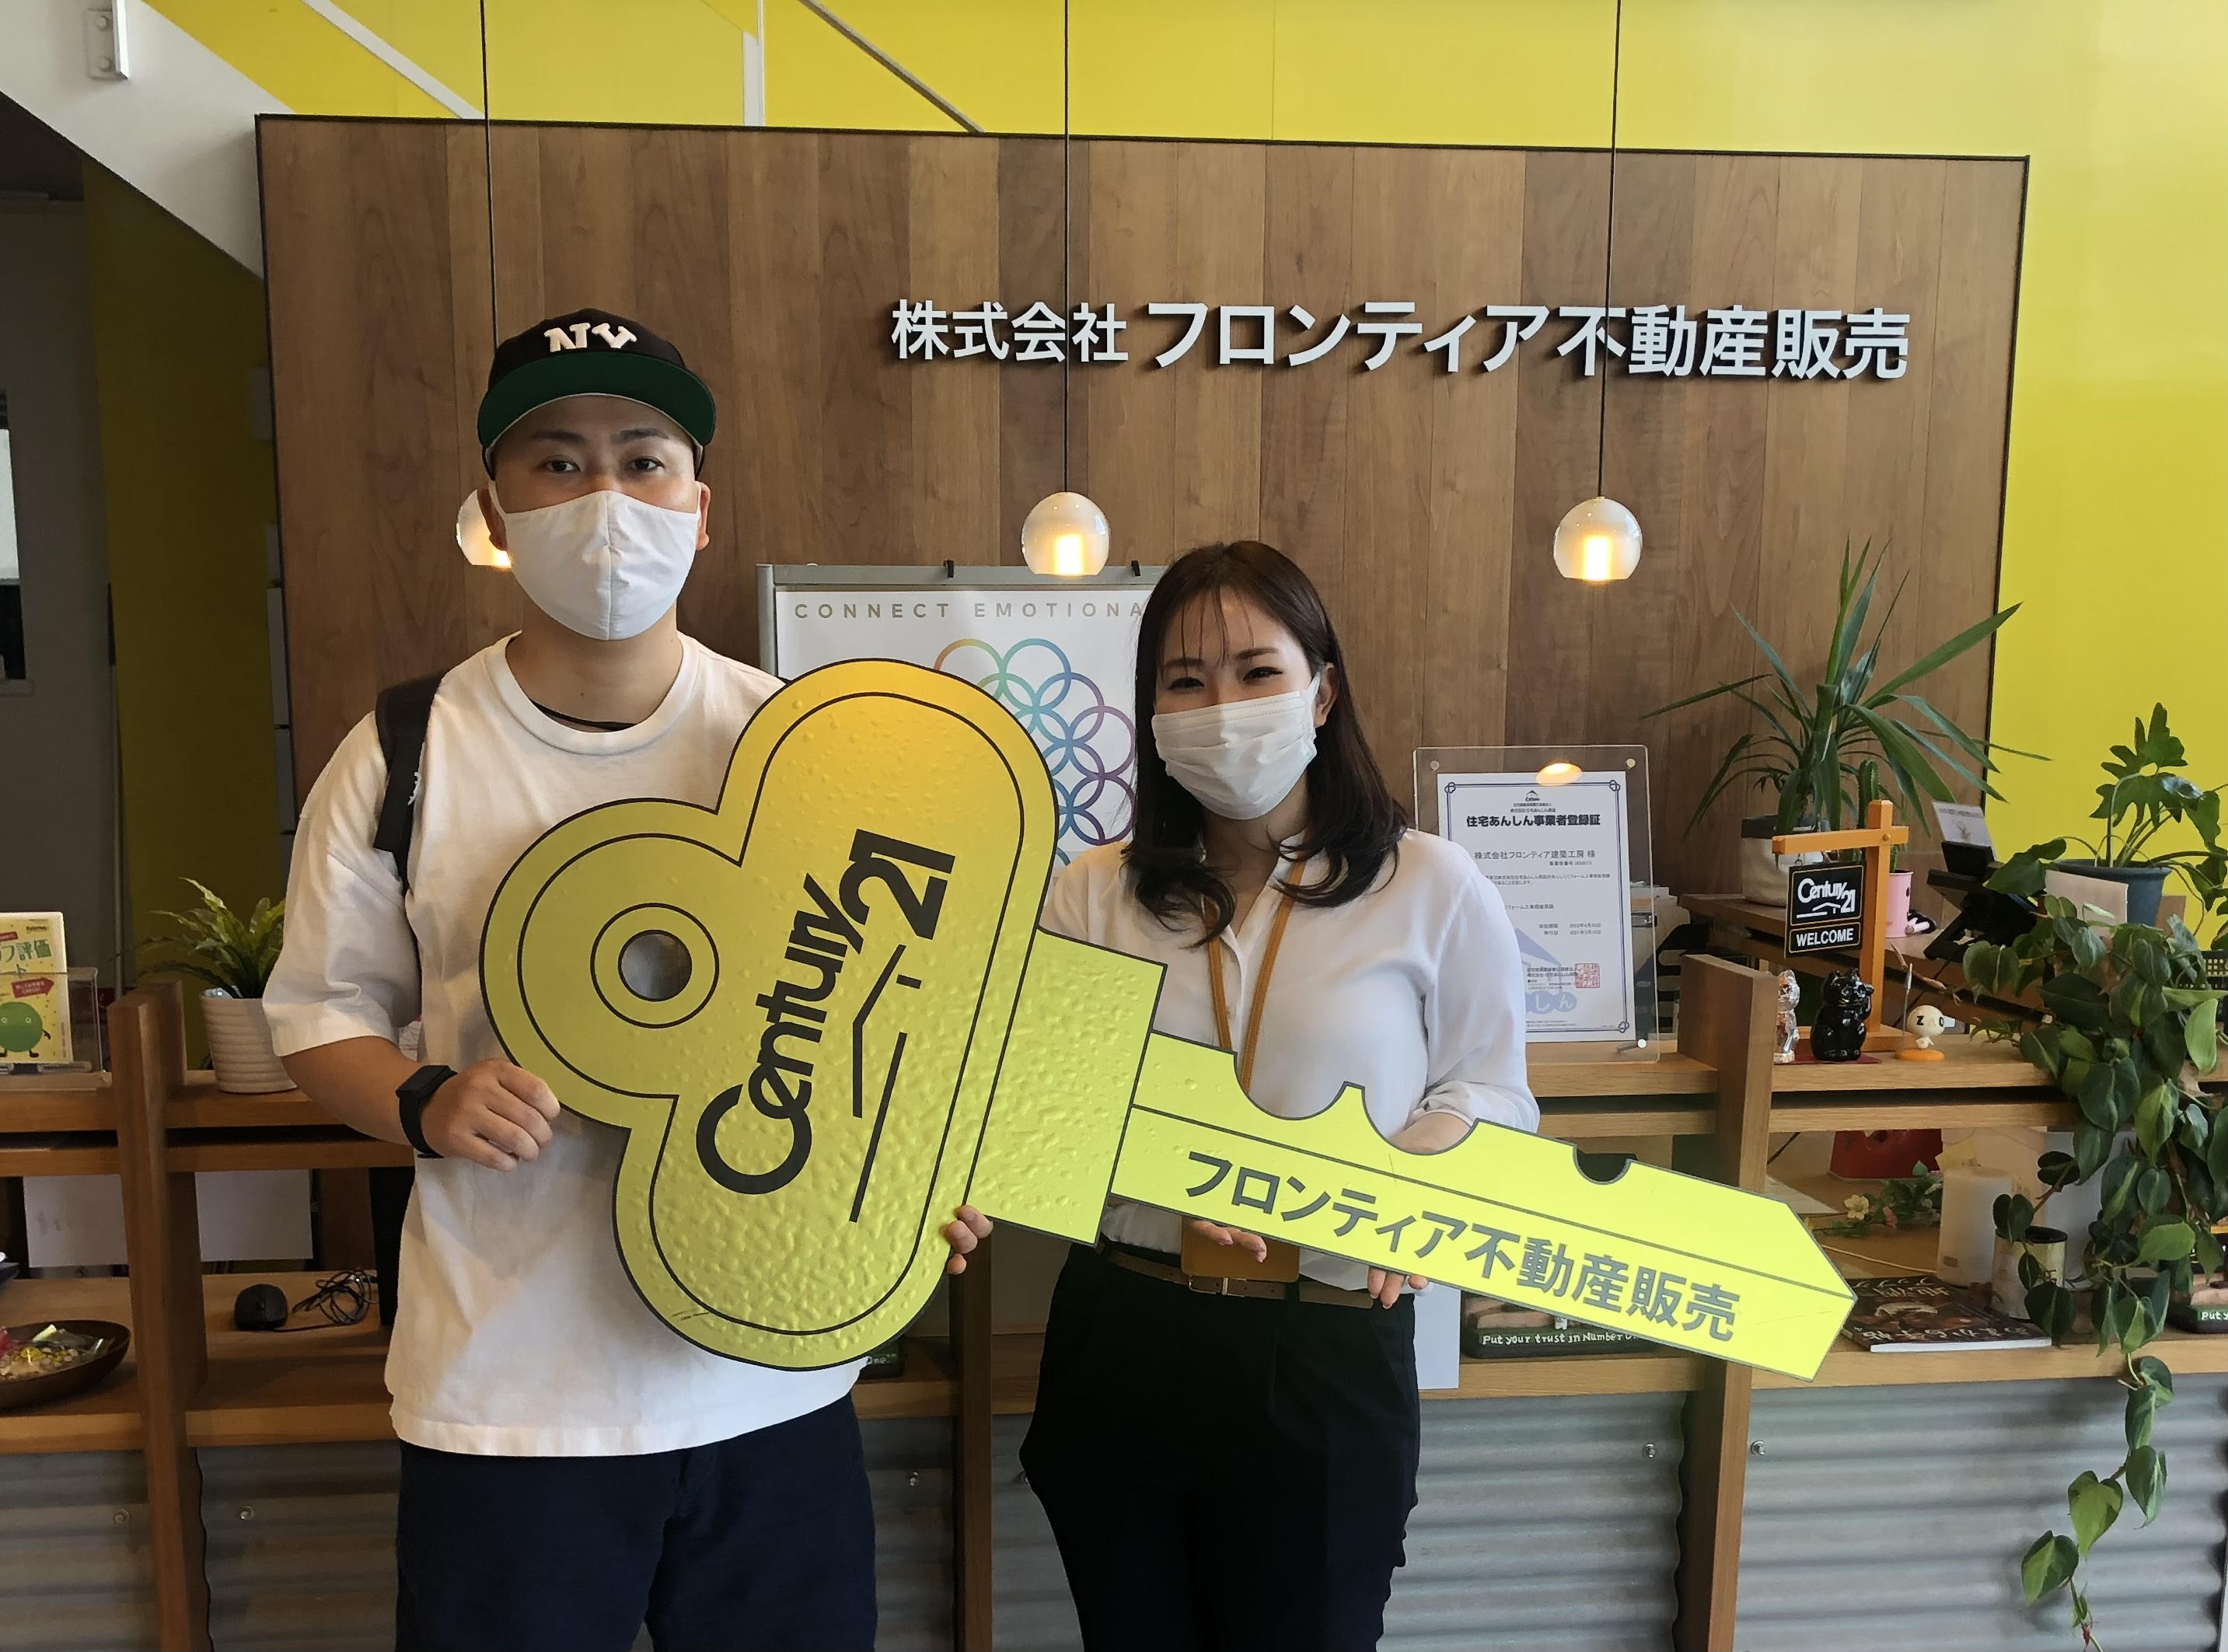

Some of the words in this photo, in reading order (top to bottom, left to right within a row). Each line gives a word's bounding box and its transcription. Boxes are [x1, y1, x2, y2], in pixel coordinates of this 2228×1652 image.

[544, 322, 637, 353] NY
[891, 299, 1129, 362] 株式会社
[1148, 301, 1910, 380] フロンティア不動産販売
[794, 602, 949, 620] CONNECT
[1466, 814, 1601, 827] 住宅あんしん事業者登録証
[1797, 878, 1848, 903] Century
[1840, 889, 1856, 913] 21
[1796, 927, 1854, 947] WELCOME
[0, 938, 52, 964] フ評価
[696, 872, 864, 1195] Century
[839, 829, 955, 940] 21
[1186, 1151, 1741, 1342] フロンティア不動産販売
[2201, 1311, 2221, 1321] Put
[1482, 1334, 1503, 1345] Put
[1505, 1333, 1531, 1345] your
[1535, 1332, 1566, 1344] trust
[1568, 1332, 1581, 1343] in
[1582, 1332, 1622, 1342] Number
